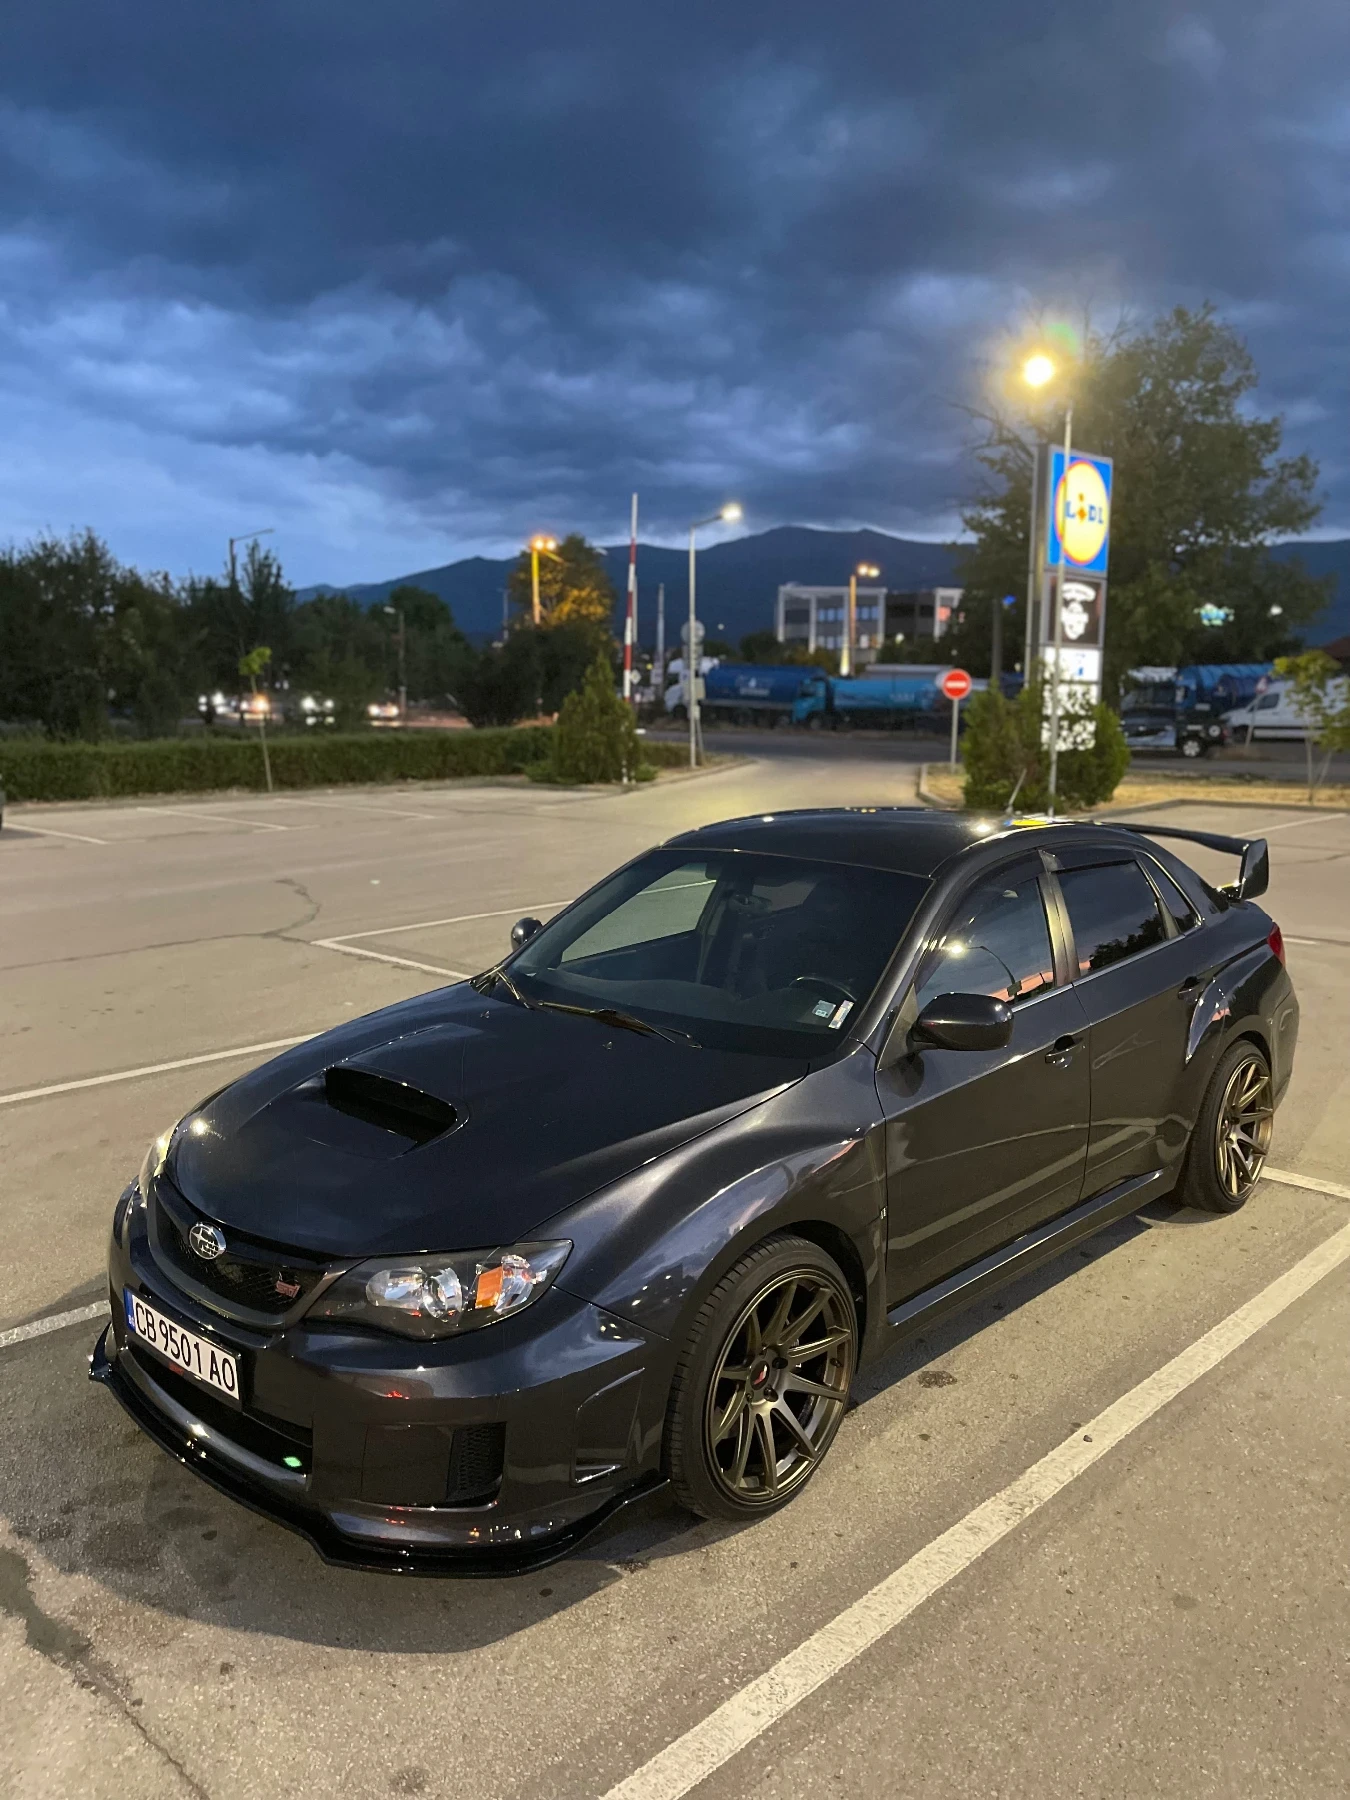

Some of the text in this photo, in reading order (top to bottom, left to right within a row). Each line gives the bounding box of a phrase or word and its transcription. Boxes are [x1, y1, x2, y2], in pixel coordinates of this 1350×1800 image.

[136, 1302, 236, 1392] CB 9501 AO
